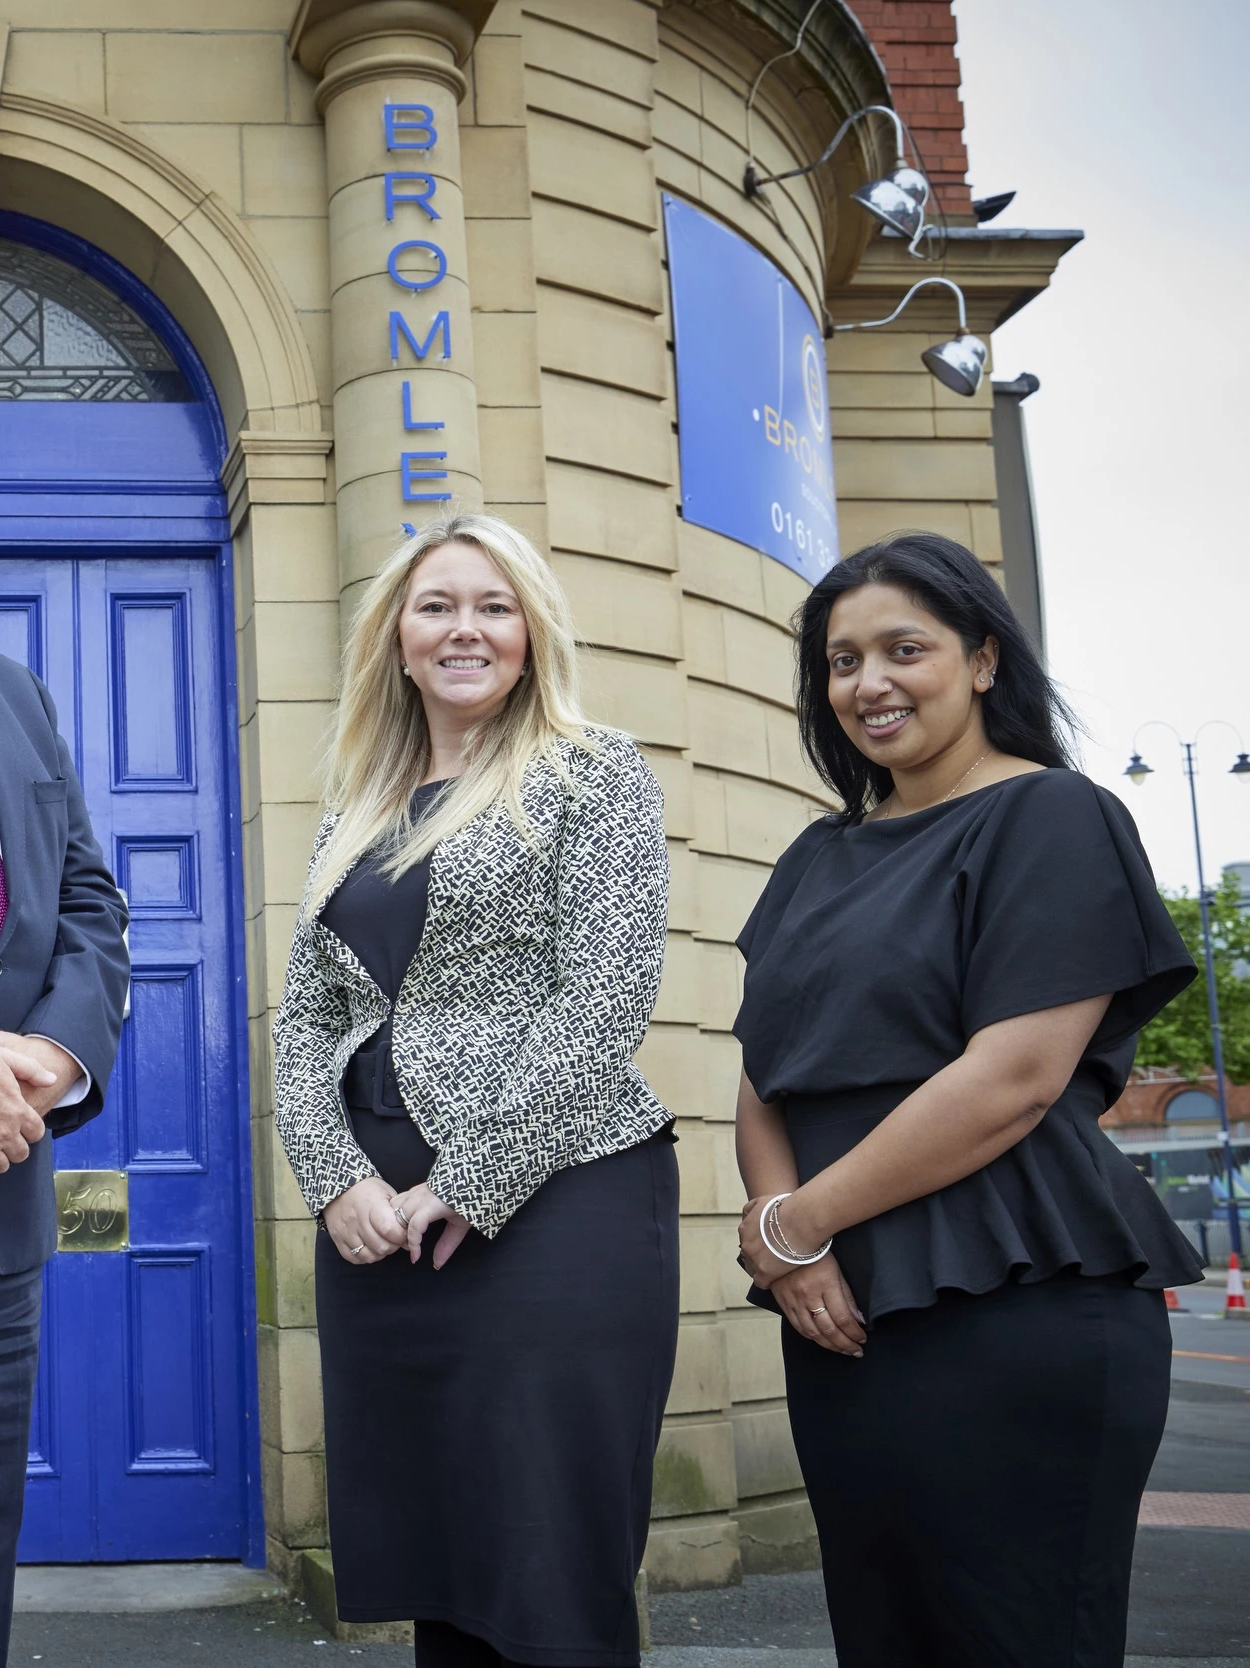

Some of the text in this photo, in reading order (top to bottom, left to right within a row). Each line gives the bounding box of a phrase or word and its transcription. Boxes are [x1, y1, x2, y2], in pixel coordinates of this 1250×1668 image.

[384, 104, 452, 537] BROMLE
[771, 501, 814, 557] 0161
[58, 1184, 118, 1235] 50
